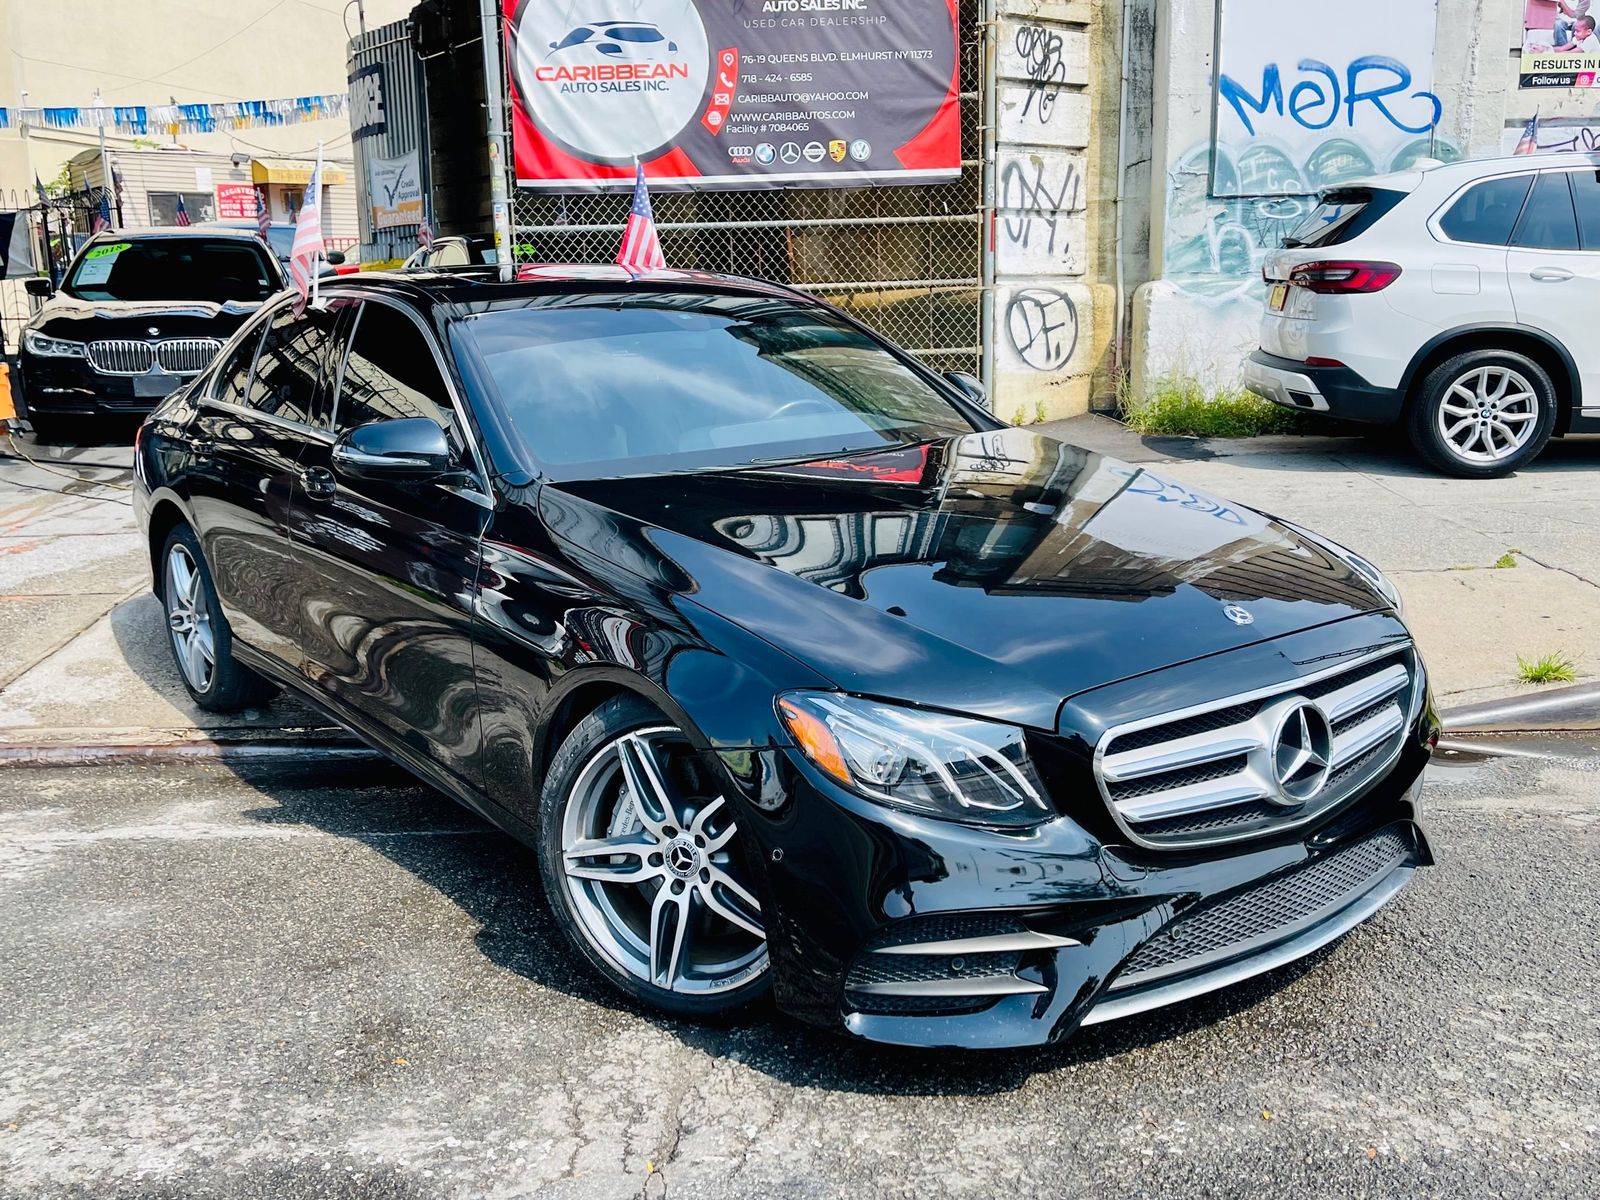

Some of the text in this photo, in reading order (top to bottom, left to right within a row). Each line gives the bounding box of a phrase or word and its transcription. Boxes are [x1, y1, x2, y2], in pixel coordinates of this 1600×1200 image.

[762, 0, 868, 12] AUTO SALES INC.
[743, 15, 887, 29] USED CAR DEALERSHIP
[741, 50, 933, 64] 76-19 QUEENS BLVD. ELMHURST NY 11373
[1533, 60, 1595, 70] RESULTS IN
[535, 63, 689, 82] CARIBBEAN
[741, 74, 757, 83] 718
[764, 73, 783, 83] 424
[789, 73, 813, 82] 6585
[1532, 76, 1558, 85] Follow
[560, 80, 670, 94] AUTO SALES INC.
[737, 91, 869, 104] CARIBBAUTO@YAHOO.COM
[730, 110, 856, 122] WWW.CARIBBAUTOS.COM
[726, 122, 810, 134] Facility # 7084065
[95, 245, 121, 257] 2018
